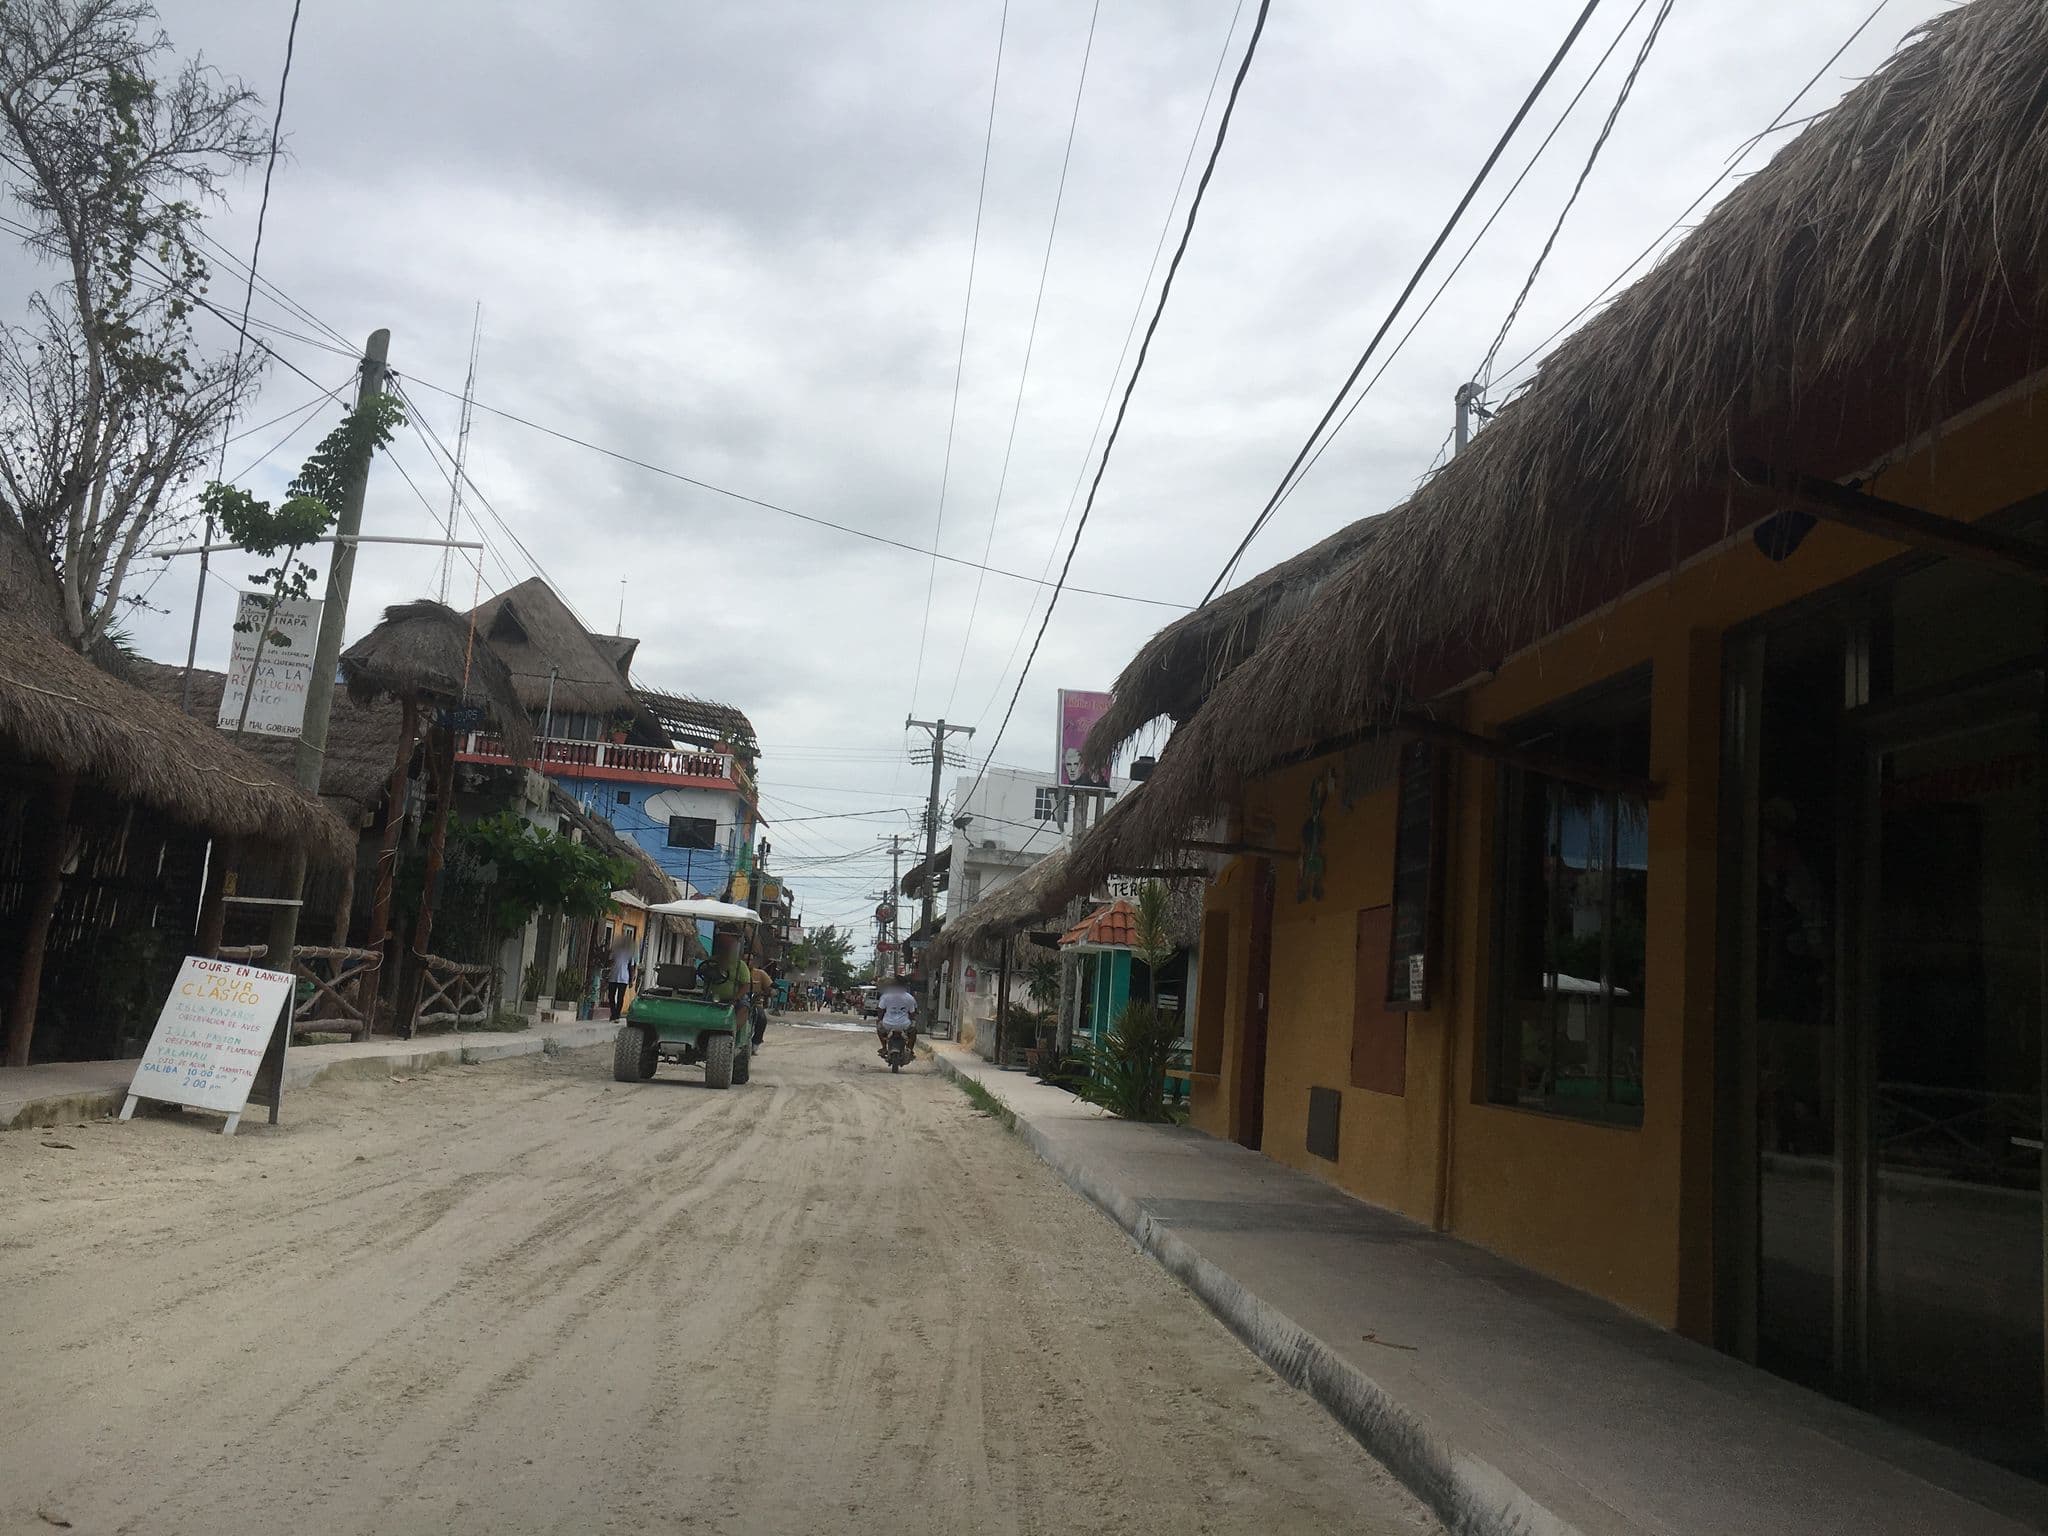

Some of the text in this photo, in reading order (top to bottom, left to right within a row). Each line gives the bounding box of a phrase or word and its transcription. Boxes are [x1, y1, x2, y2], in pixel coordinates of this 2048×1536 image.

[240, 614, 307, 627] AYOTINAPA
[242, 664, 301, 681] VVA LA
[232, 674, 303, 692] REOLUCION
[192, 960, 289, 984] TOURS EN LANCHA
[206, 974, 253, 992] TOUR
[182, 983, 259, 1005] CLASICO
